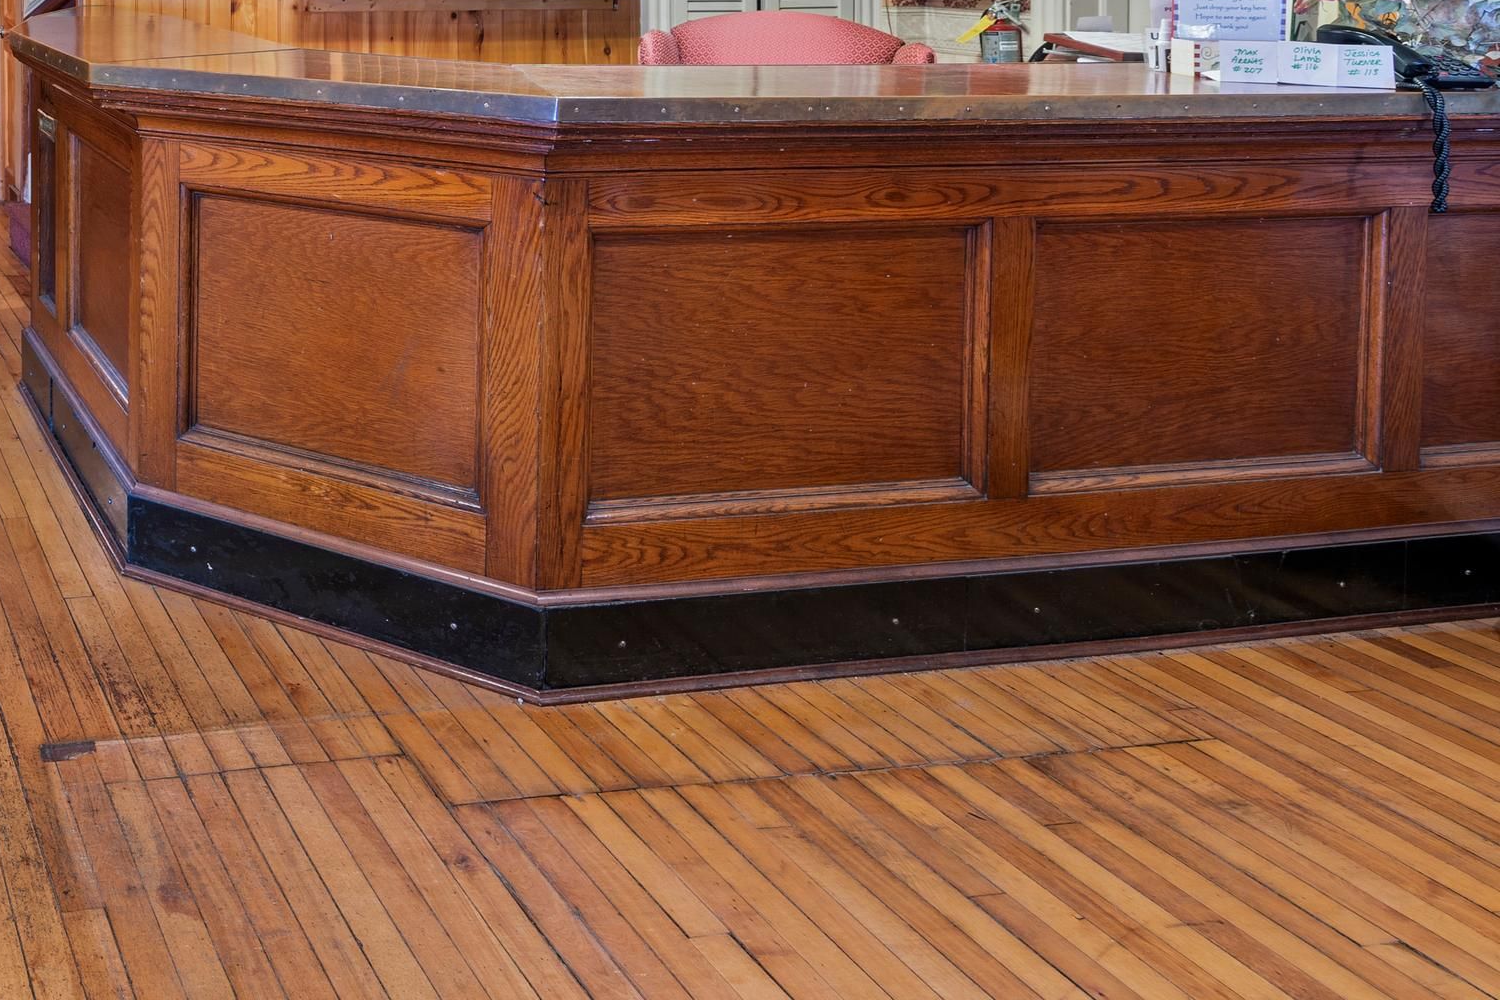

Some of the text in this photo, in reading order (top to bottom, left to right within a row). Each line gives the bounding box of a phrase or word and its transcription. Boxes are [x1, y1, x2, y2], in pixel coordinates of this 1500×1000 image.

[1193, 3, 1209, 11] Just
[1240, 3, 1252, 12] key
[1195, 12, 1214, 23] Hope
[1244, 65, 1263, 74] 207
